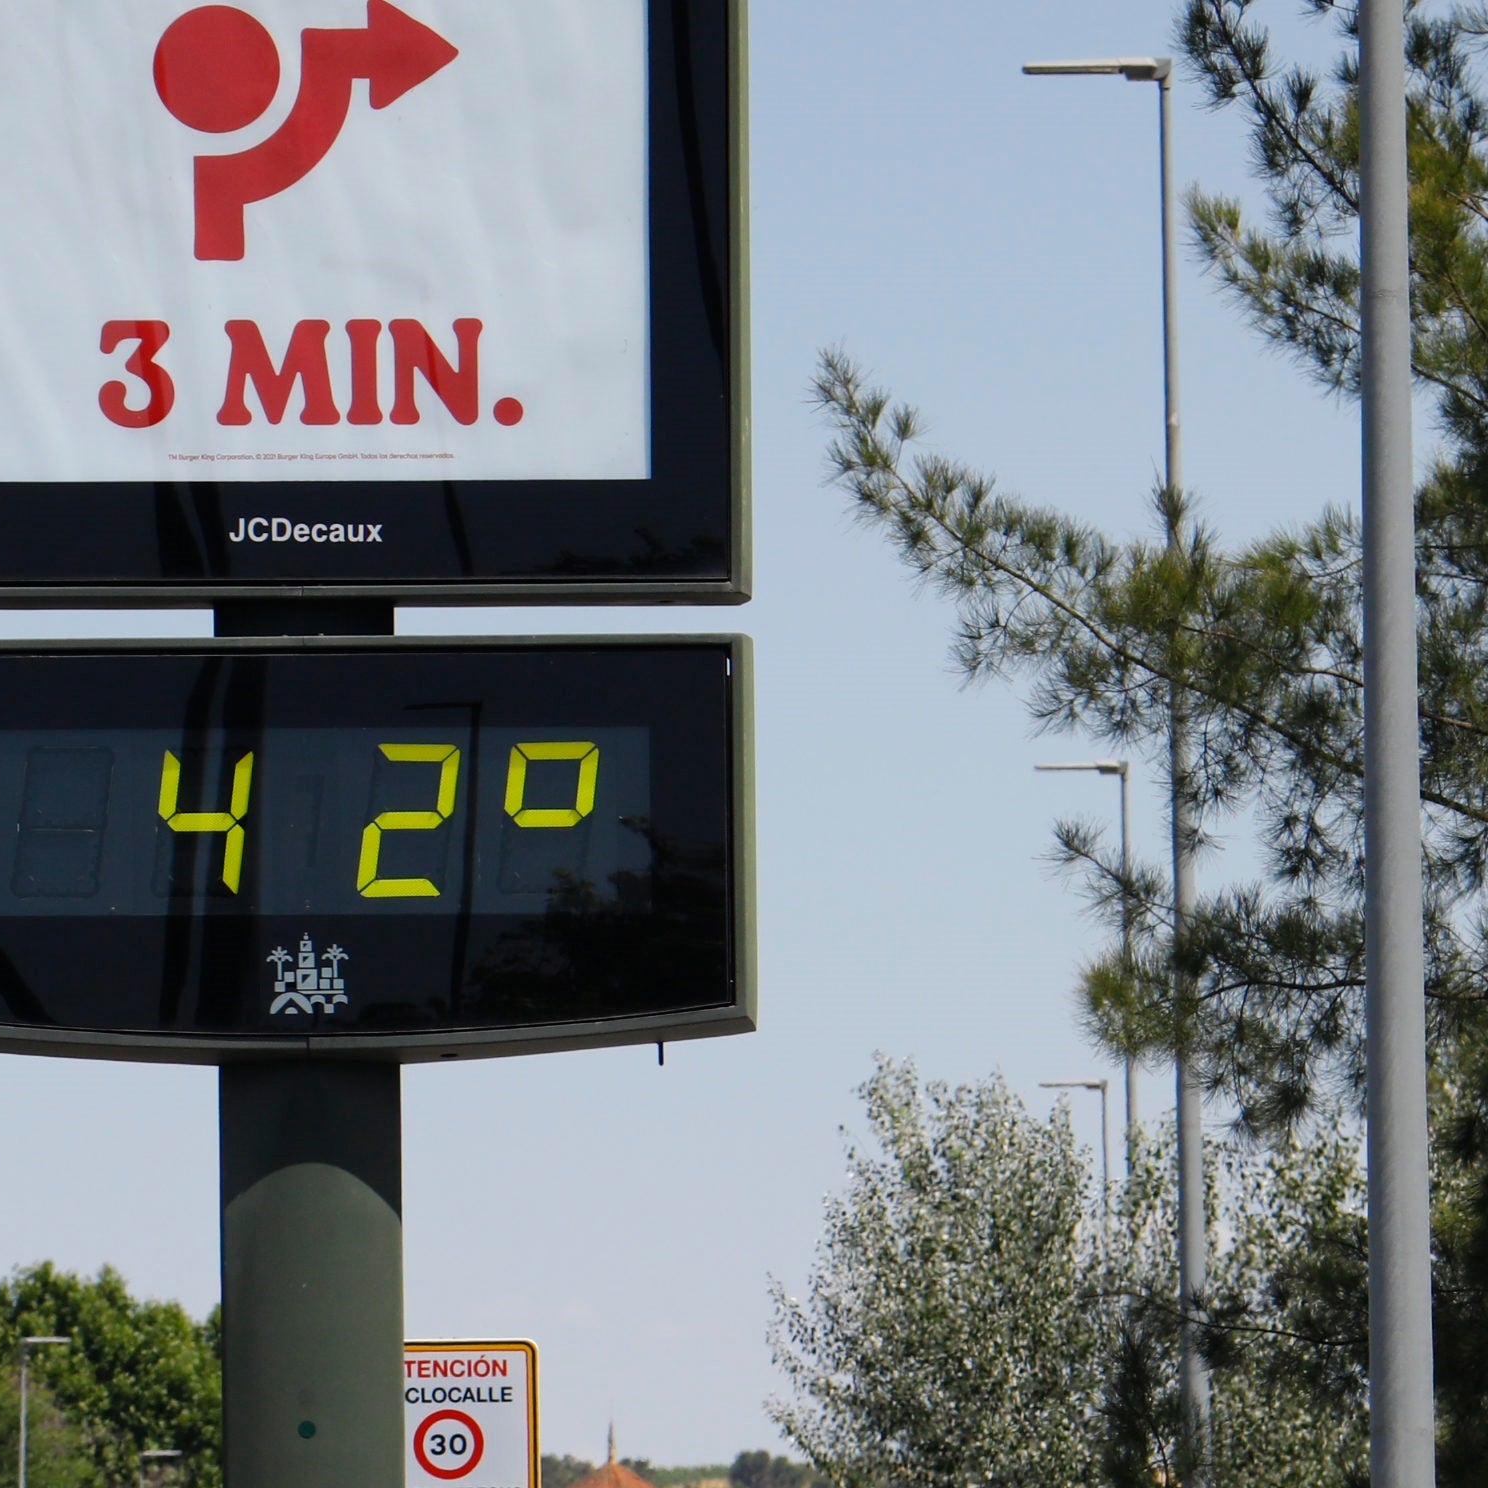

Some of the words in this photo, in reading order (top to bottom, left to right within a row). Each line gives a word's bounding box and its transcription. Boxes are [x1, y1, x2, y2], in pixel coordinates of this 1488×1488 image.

[100, 319, 175, 429] 3
[217, 318, 524, 427] MIN.
[228, 516, 384, 543] JCDecaux
[404, 1354, 509, 1379] TENCIÓN
[404, 1386, 514, 1404] CLOCALLE
[429, 1433, 468, 1457] 30
